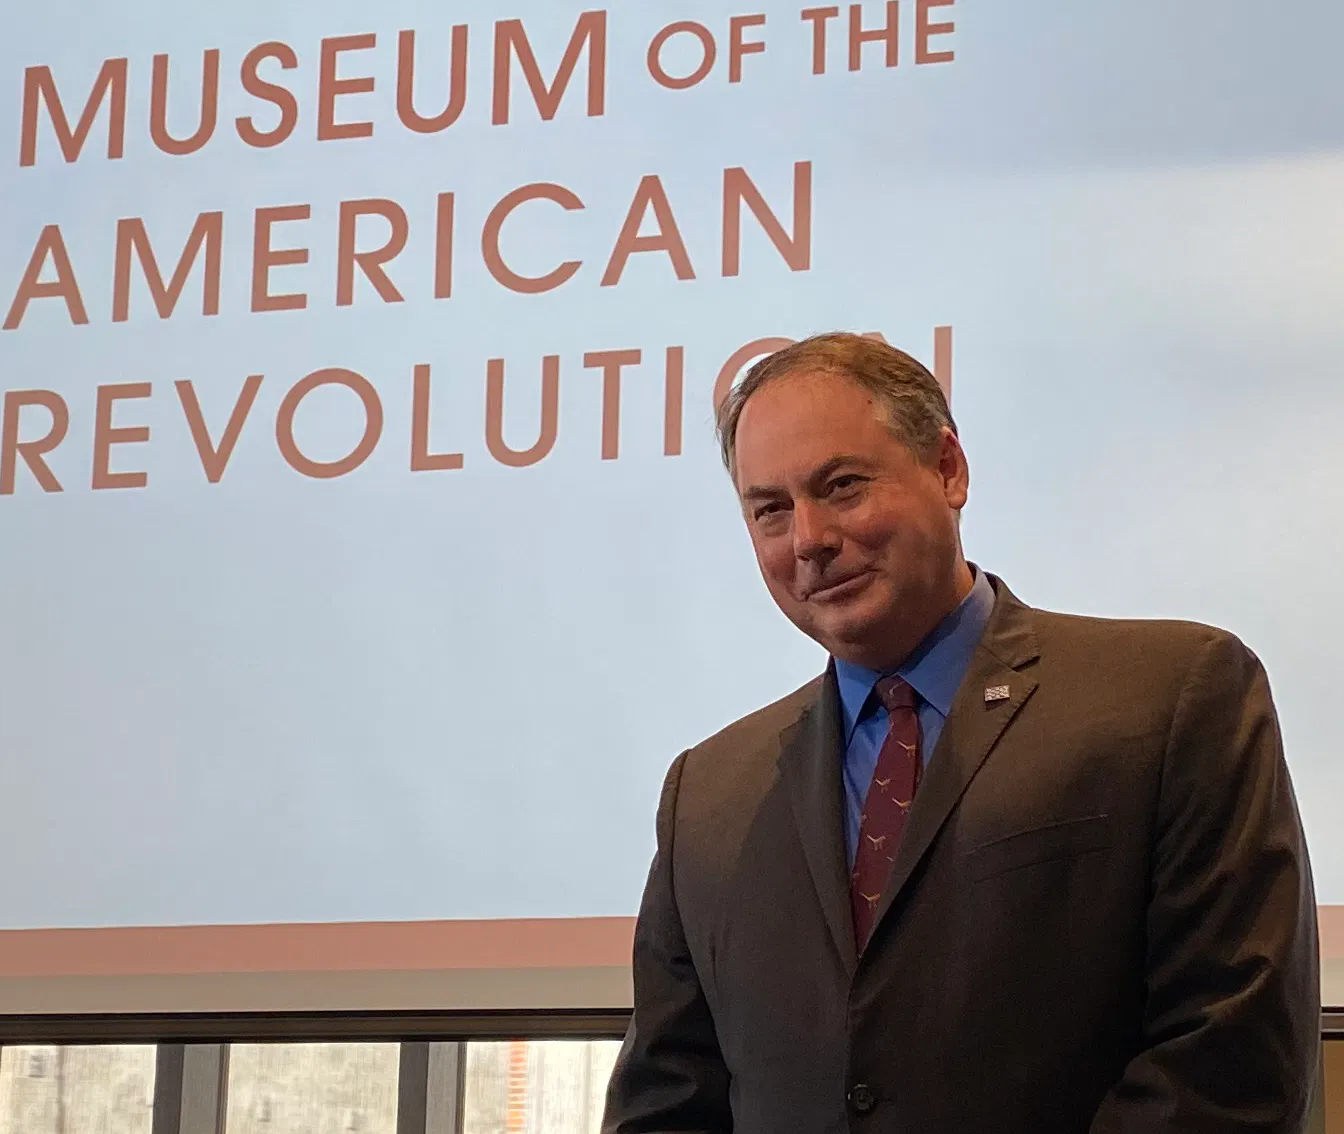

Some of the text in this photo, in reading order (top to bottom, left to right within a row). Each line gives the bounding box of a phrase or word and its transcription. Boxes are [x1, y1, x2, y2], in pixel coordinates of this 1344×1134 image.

[19, 0, 956, 168] MUSEUM OF THE
[0, 160, 814, 331] AMERICAN
